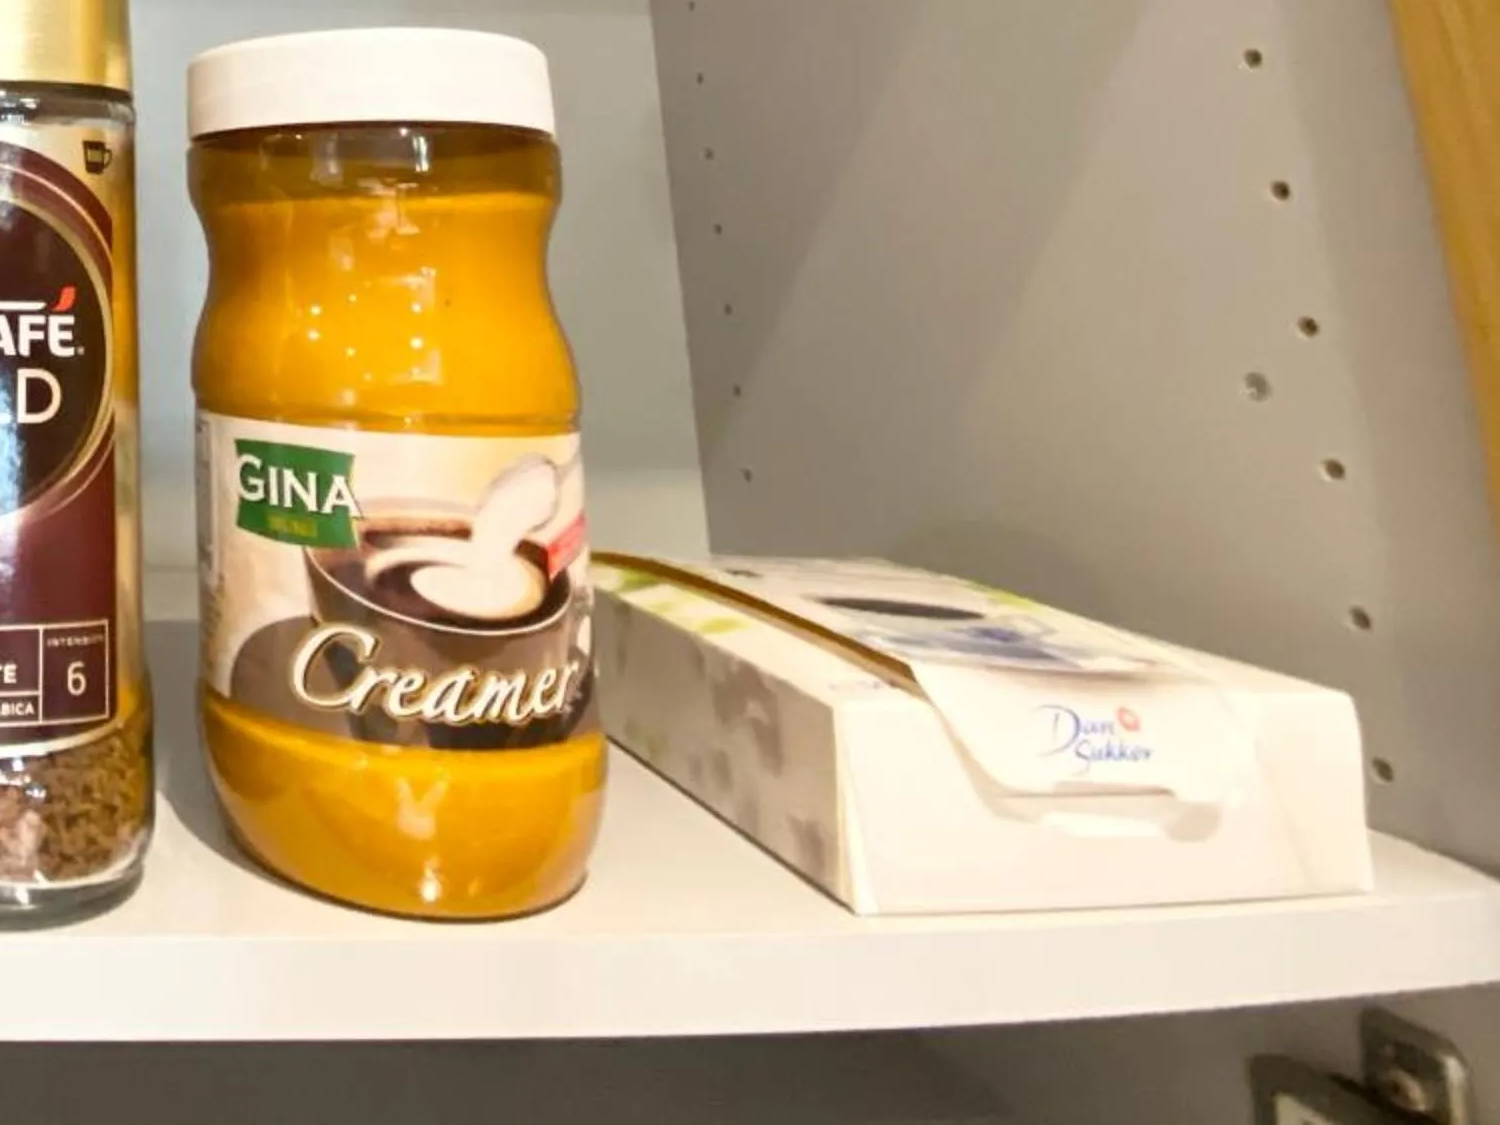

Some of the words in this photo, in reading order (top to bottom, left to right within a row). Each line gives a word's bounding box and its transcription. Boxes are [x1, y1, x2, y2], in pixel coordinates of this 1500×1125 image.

[238, 454, 364, 517] GINA
[66, 660, 88, 697] 6
[292, 624, 582, 727] Creamer
